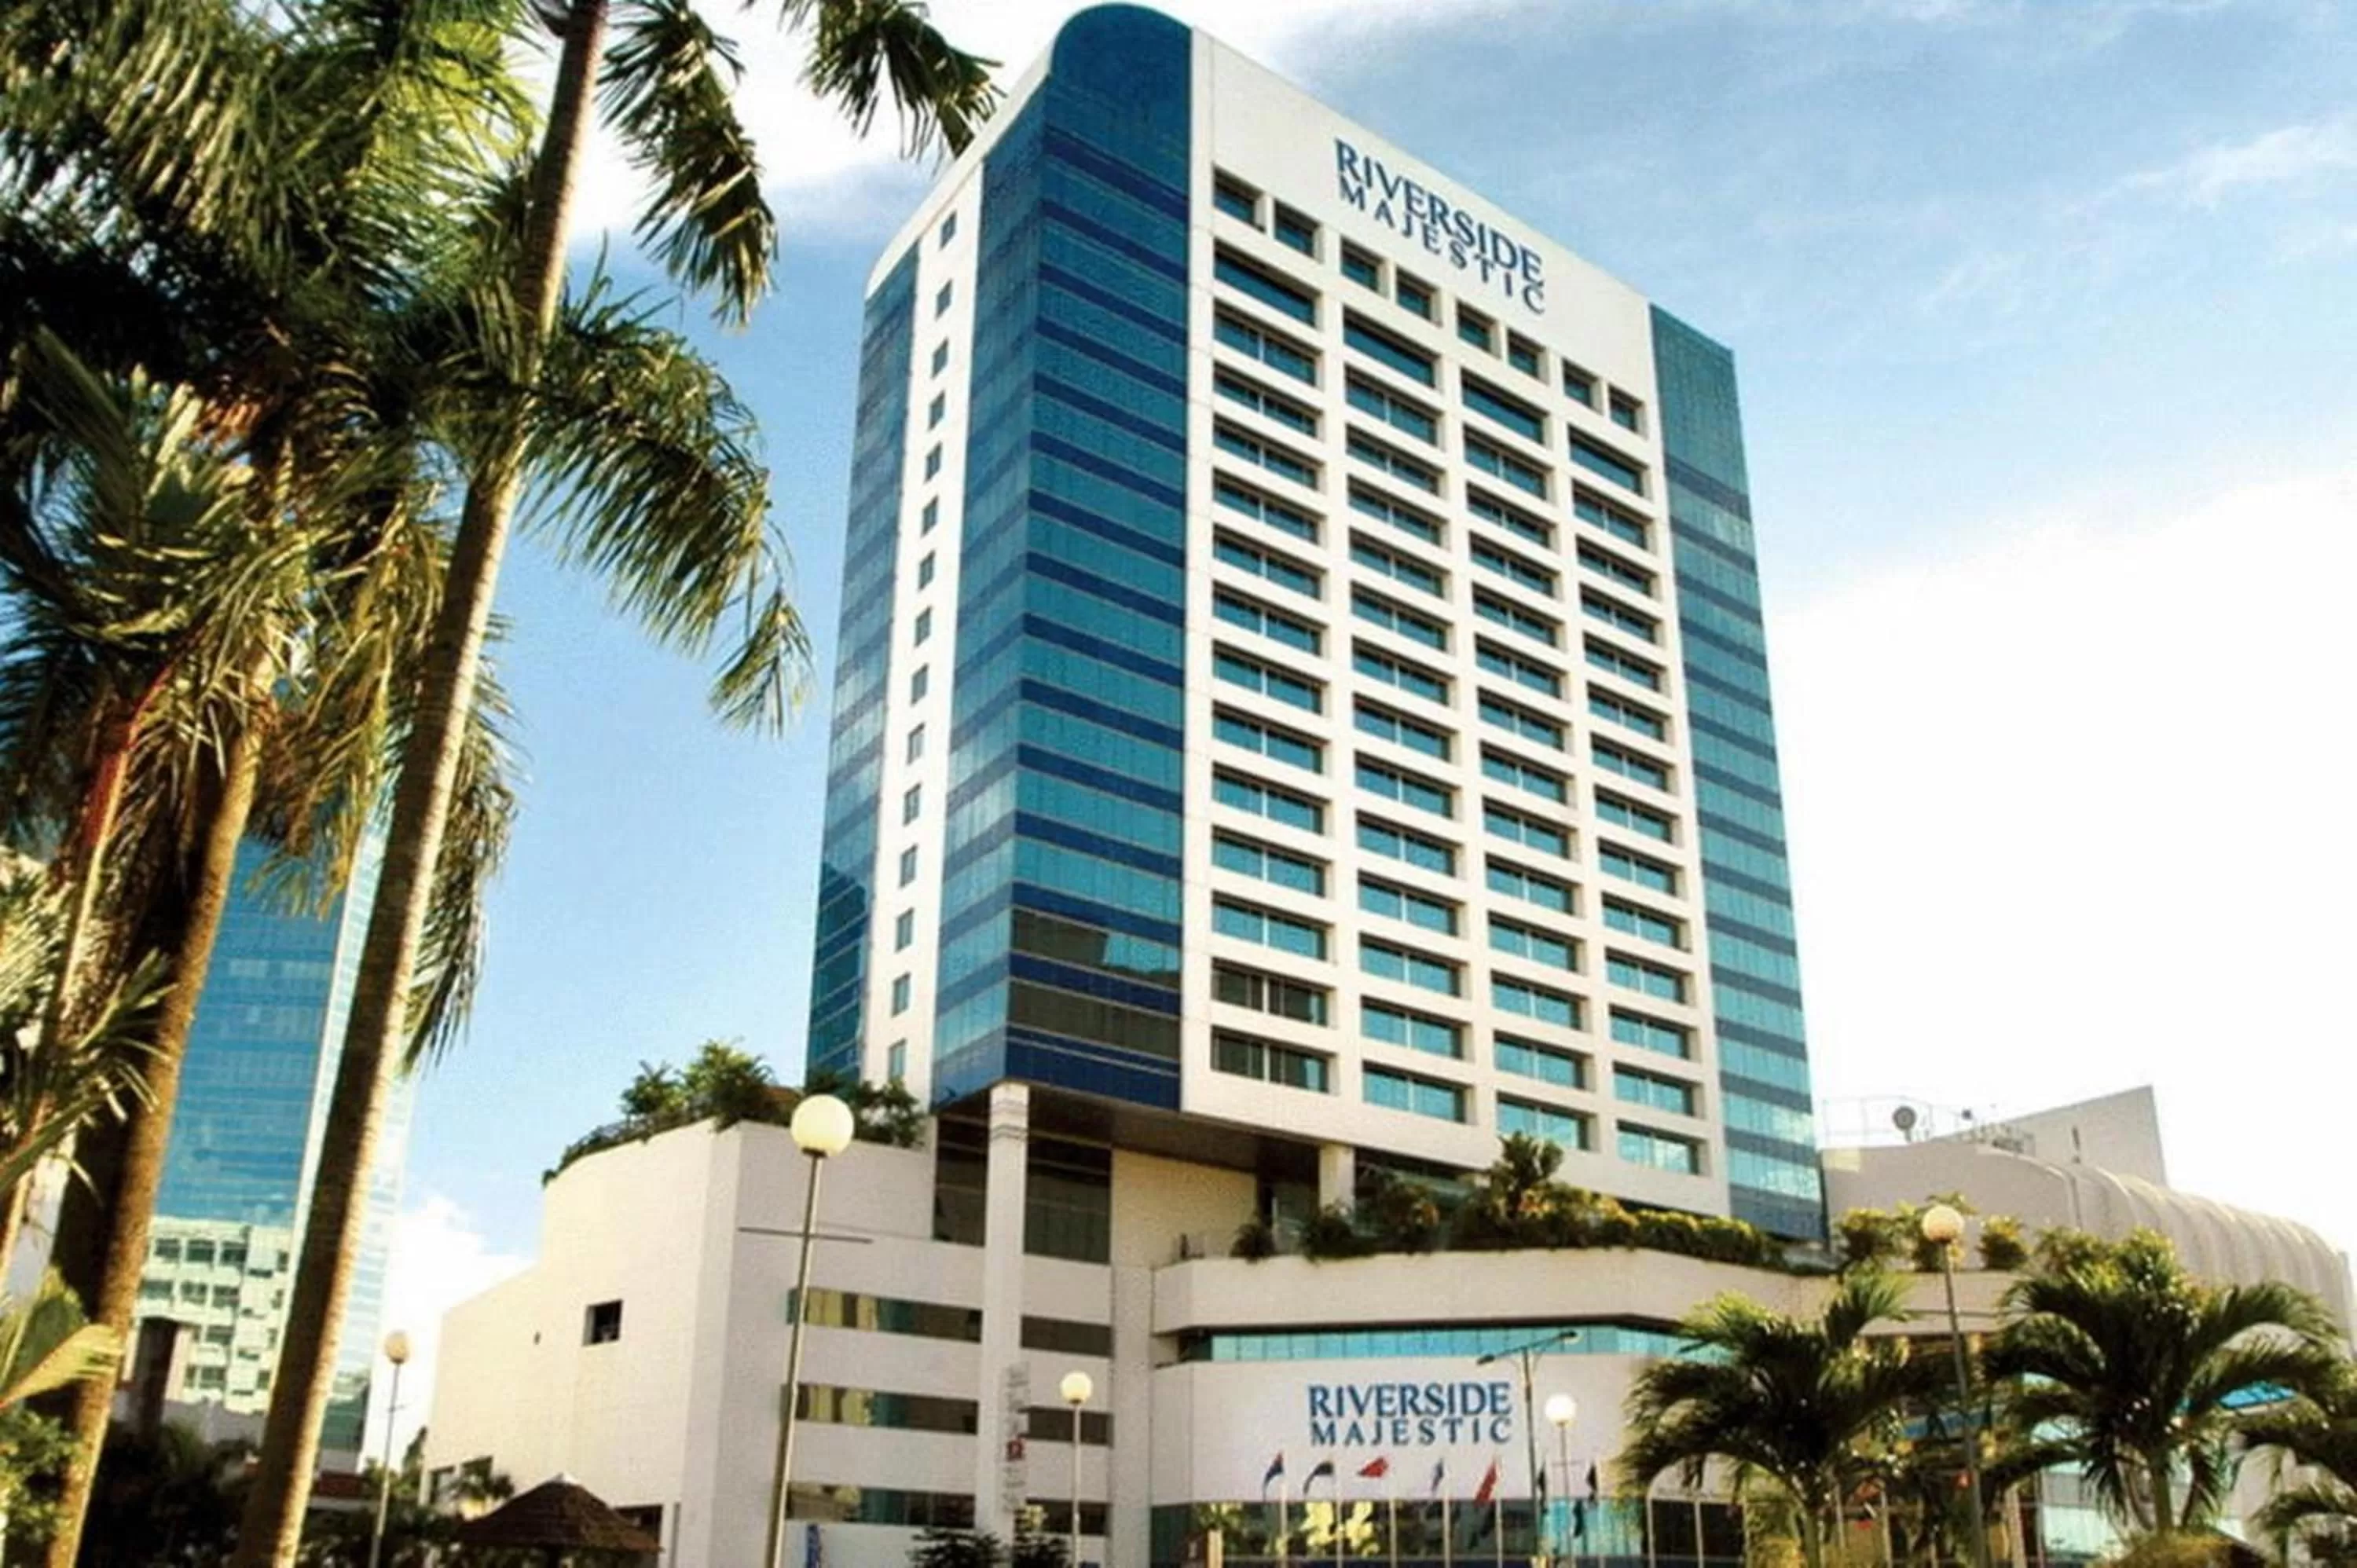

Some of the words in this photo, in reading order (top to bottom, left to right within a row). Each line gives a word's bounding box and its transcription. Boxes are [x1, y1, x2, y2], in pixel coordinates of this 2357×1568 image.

[1334, 138, 1544, 282] RIVERSIDE
[1340, 174, 1545, 314] MAJESTIC
[1308, 1382, 1512, 1416] RIVERSIDE
[1310, 1417, 1512, 1445] MAJESTIC
